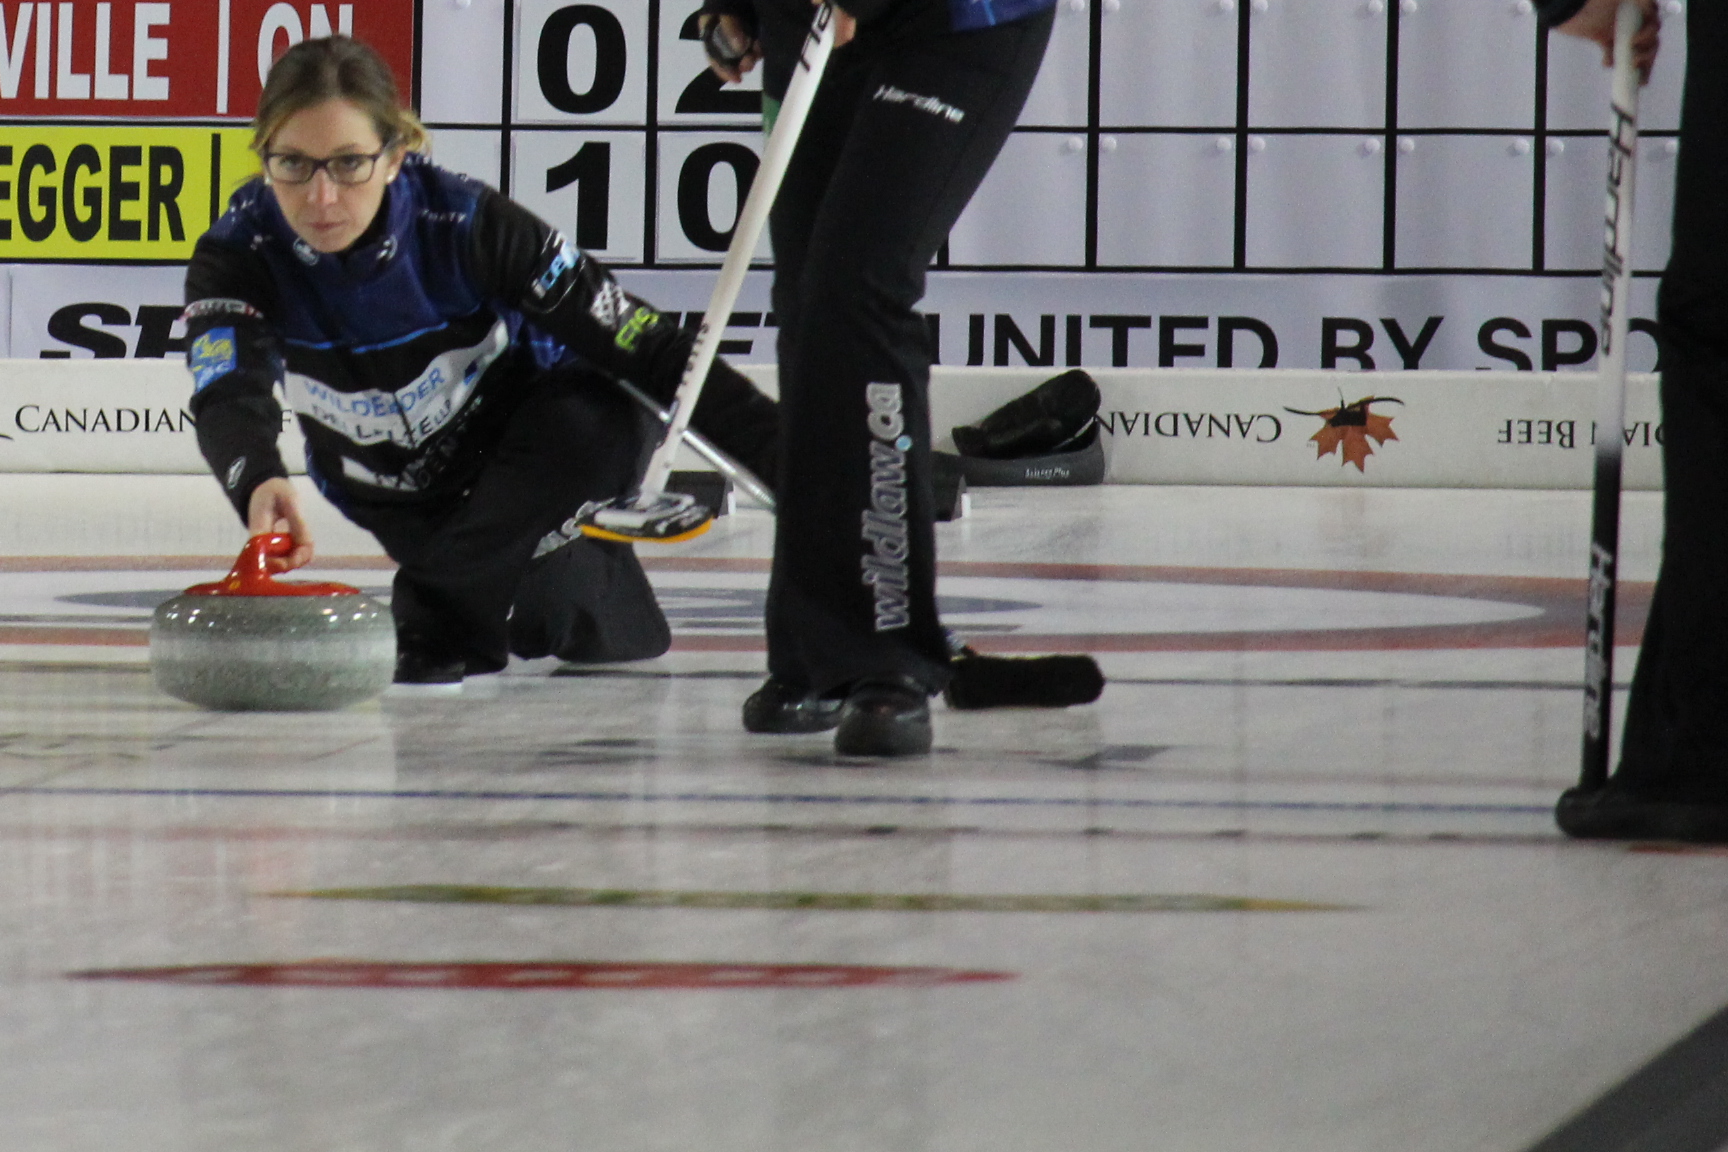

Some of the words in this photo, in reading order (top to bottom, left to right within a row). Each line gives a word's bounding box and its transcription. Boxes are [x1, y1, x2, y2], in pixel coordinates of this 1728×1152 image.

[536, 4, 627, 115] 0
[872, 84, 966, 125] Hardline
[545, 141, 611, 251] 1
[676, 142, 764, 253] 0
[1596, 102, 1635, 358] Hardline
[927, 313, 1279, 370] UNITED
[1320, 316, 1445, 371] BY
[1497, 418, 1577, 449] BEEF
[861, 381, 913, 632] wildlaw.ca
